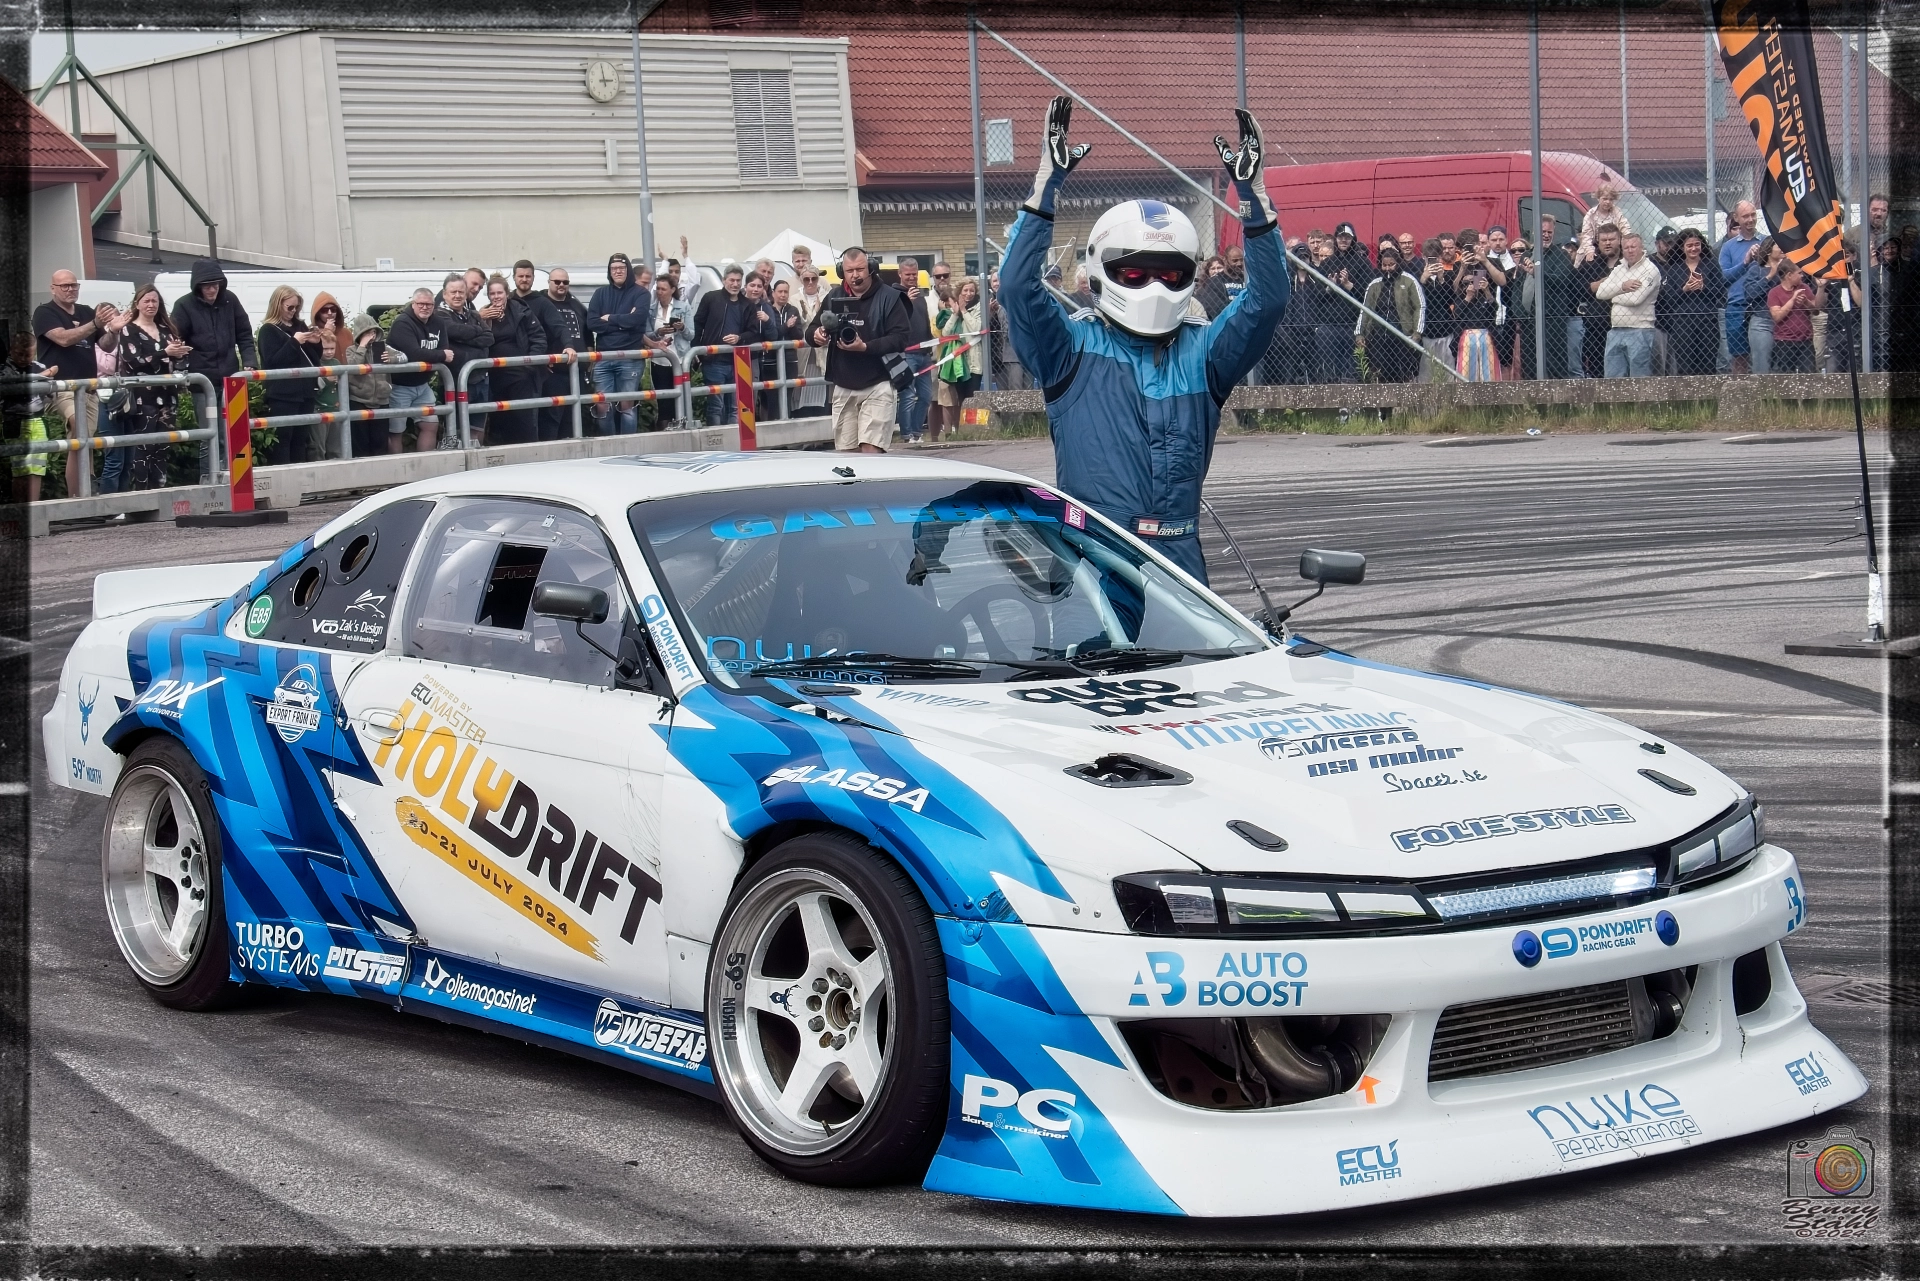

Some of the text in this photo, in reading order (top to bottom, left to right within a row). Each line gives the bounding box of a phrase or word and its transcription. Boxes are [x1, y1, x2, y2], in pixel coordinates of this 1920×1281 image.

[1145, 232, 1173, 241] SIMPSON
[710, 500, 1058, 541] GATEBIL
[250, 607, 271, 624] E85
[339, 618, 359, 633] Zak's
[360, 621, 383, 637] Design
[649, 625, 673, 671] RACING GEAR
[656, 619, 695, 681] PONYDRIFT
[422, 673, 473, 714] POWERED BY
[1007, 676, 1183, 704] auto
[268, 706, 319, 727] EXPORT FROM US
[410, 681, 487, 746] ECU MASTER
[72, 757, 103, 785] 59° NORTH
[1394, 805, 1636, 853] FOLIESTYLE
[467, 858, 514, 895] JULY
[523, 894, 569, 937] 2024
[235, 922, 304, 951] TURBO
[1577, 916, 1654, 943] PONYDRIFT
[1582, 936, 1637, 953] RACING GEAR
[237, 945, 321, 977] SYSTEMS
[726, 952, 747, 991] 59°
[1215, 951, 1309, 979] AUTO
[445, 972, 537, 1016] oljemagasinet
[1197, 981, 1309, 1007] BOOST
[621, 1014, 707, 1064] WISEFAB
[1785, 1054, 1826, 1086] ECU
[1798, 1076, 1832, 1097] MASTER
[1526, 1083, 1686, 1139] nuke
[961, 1114, 993, 1128] slang
[1004, 1123, 1069, 1140] maskiner
[1335, 1139, 1399, 1176] ECU
[1339, 1166, 1402, 1187] MASTER
